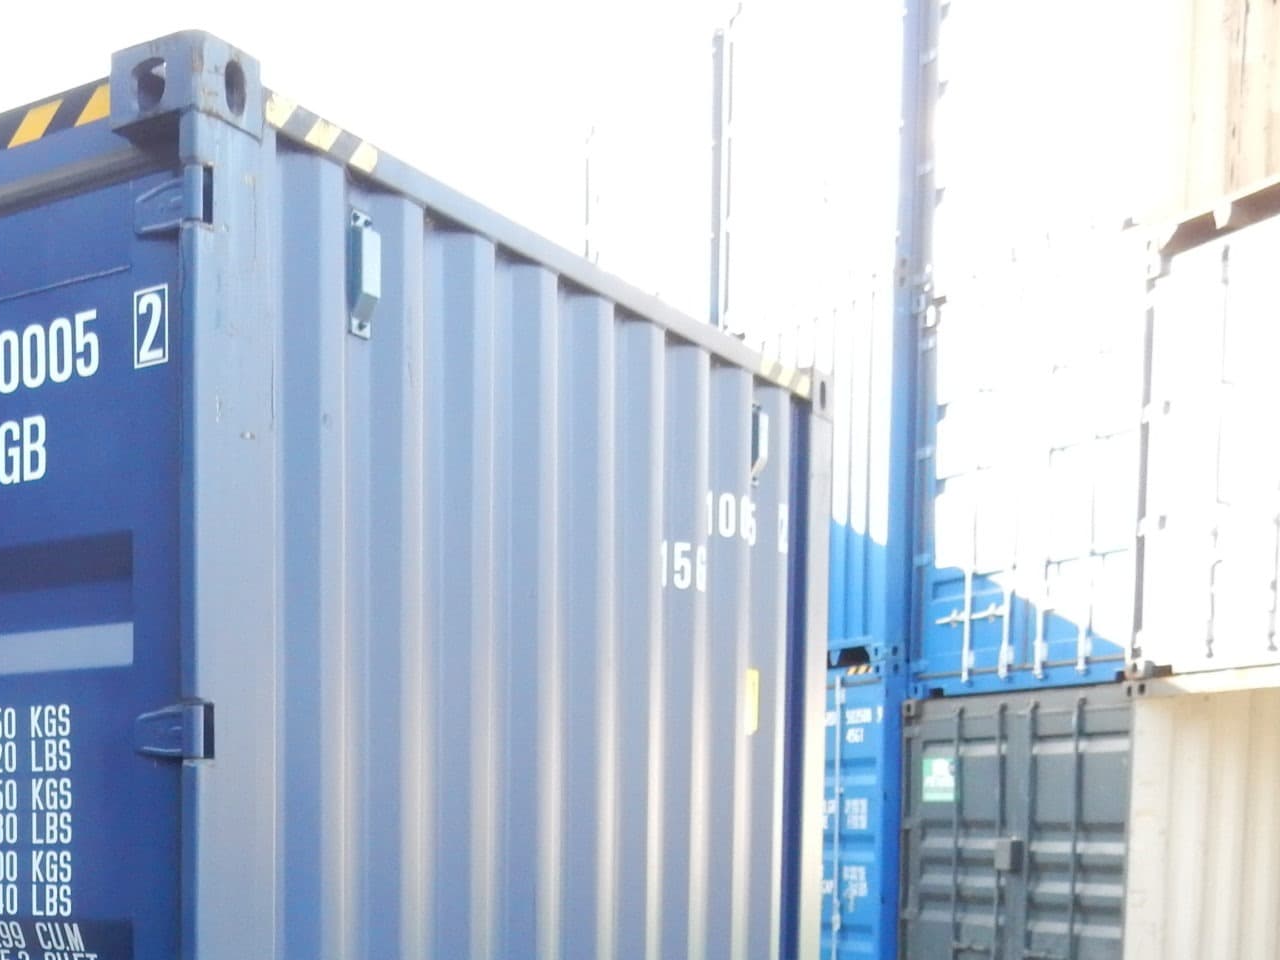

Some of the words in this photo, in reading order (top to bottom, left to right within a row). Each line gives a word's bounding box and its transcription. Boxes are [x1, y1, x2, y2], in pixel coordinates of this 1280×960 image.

[136, 290, 166, 365] 2
[30, 704, 71, 738] KGS
[31, 738, 72, 772] LBS
[32, 777, 72, 810] KGS
[32, 811, 73, 844] LBS
[32, 850, 72, 882] KGS
[32, 884, 72, 917] LBS
[35, 921, 86, 952] CU.M
